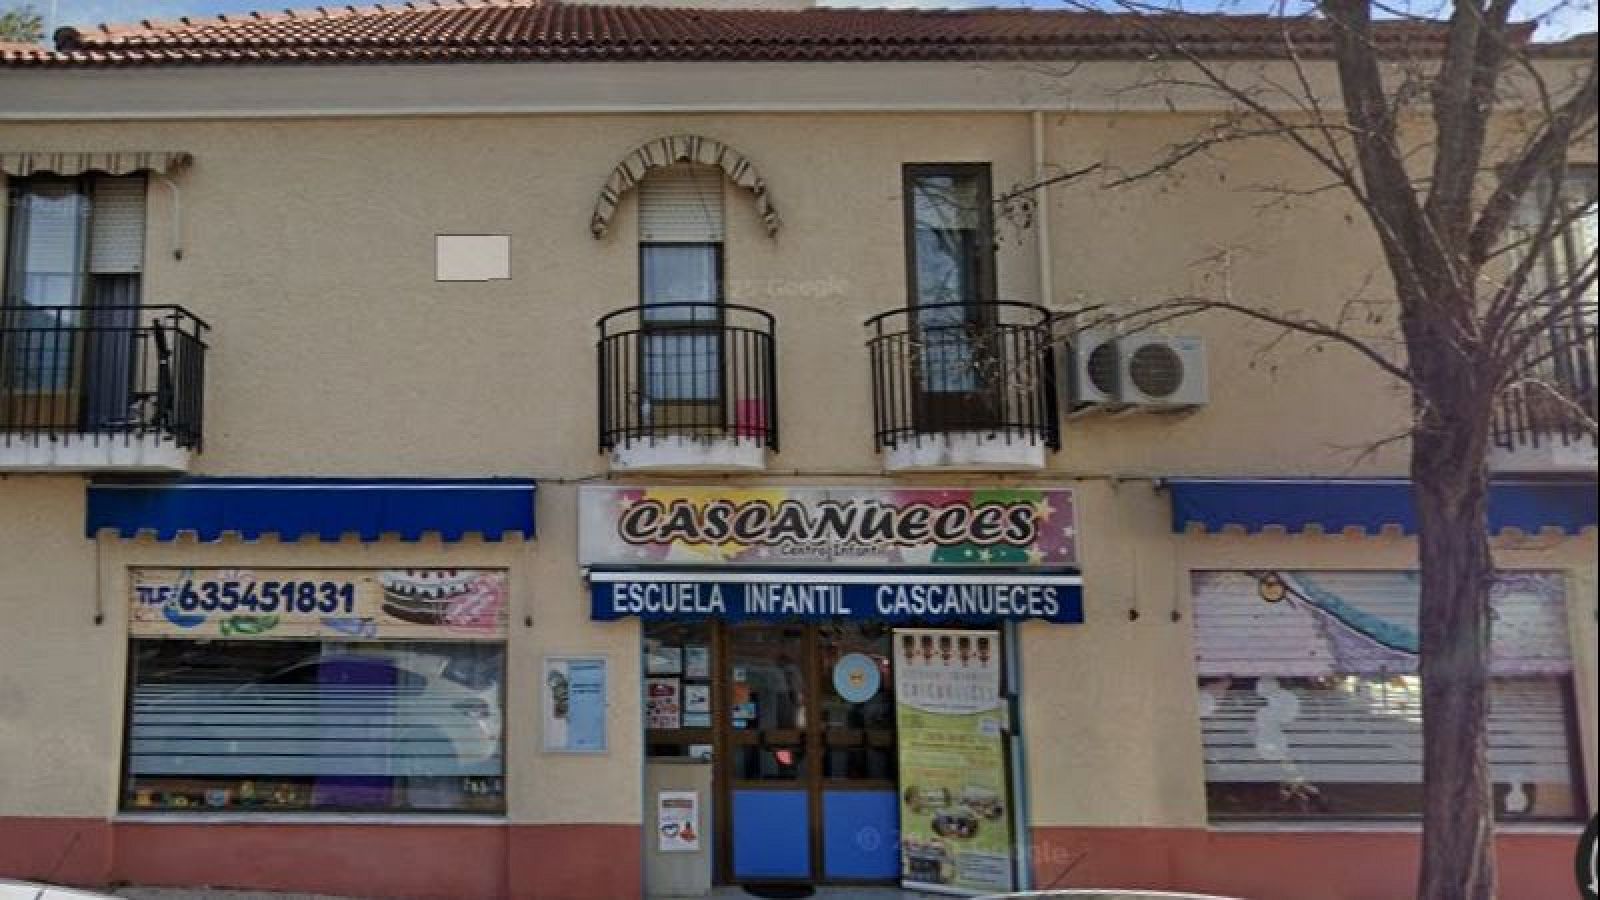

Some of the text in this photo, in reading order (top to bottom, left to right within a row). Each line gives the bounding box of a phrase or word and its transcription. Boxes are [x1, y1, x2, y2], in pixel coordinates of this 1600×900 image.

[621, 500, 1037, 543] CASCANUECES
[179, 580, 354, 613] 635451831
[613, 583, 1060, 615] ESCUELA INFANTIL CASCANUECES
